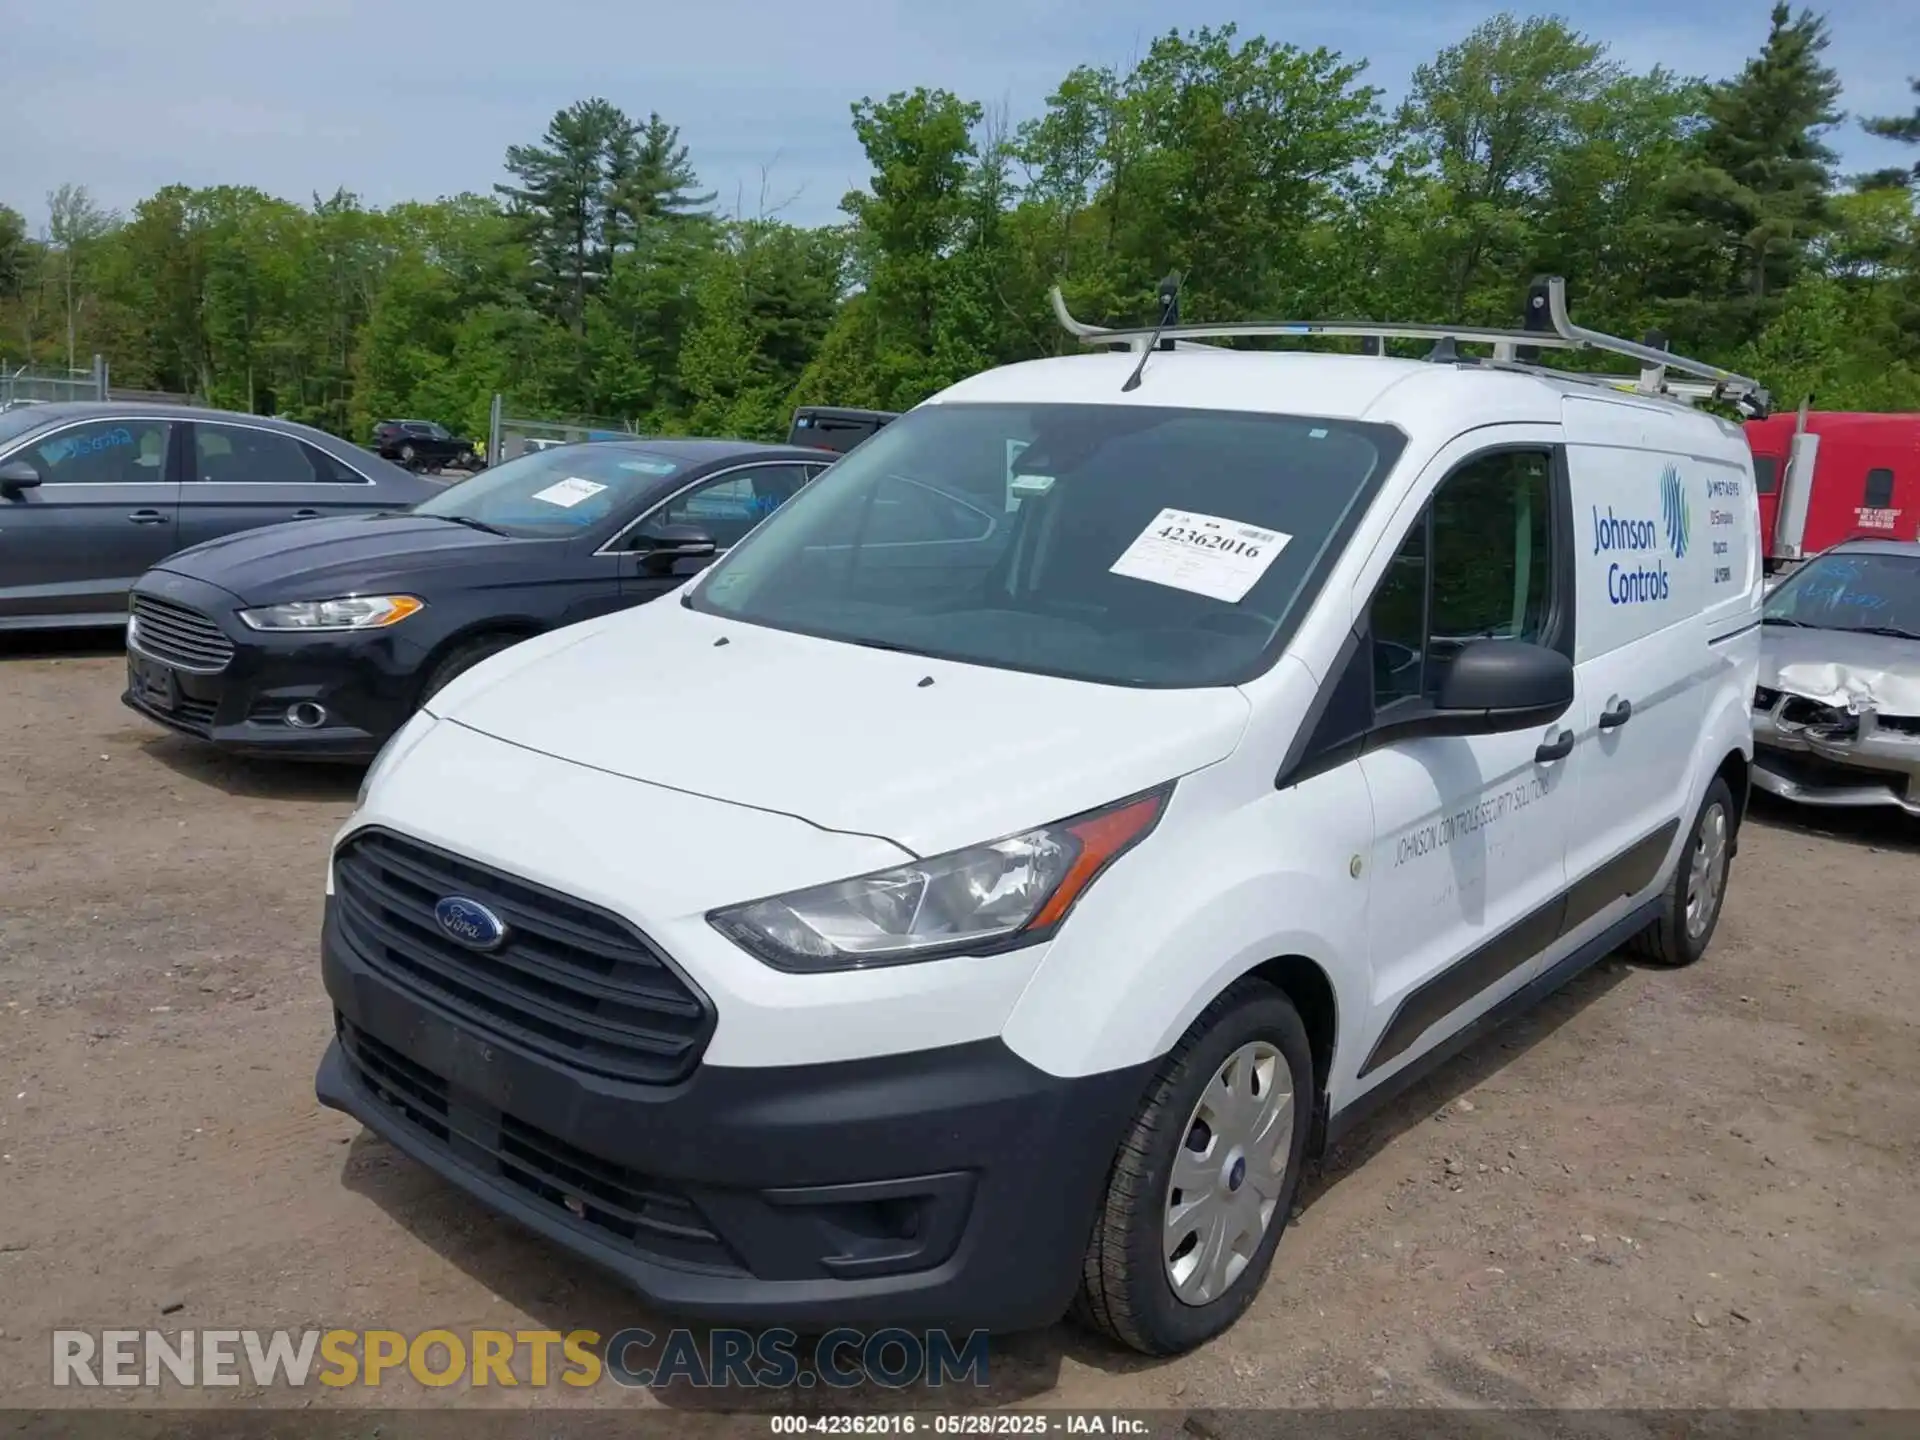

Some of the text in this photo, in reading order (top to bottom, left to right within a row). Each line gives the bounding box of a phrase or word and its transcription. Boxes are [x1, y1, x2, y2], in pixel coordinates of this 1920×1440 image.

[1158, 526, 1261, 558] 42362016
[1593, 505, 1657, 556] Johnson
[1608, 559, 1669, 605] Controls
[1394, 825, 1437, 868] JOHNSON
[1438, 805, 1479, 846] CONTROLS
[443, 904, 481, 939] Ford
